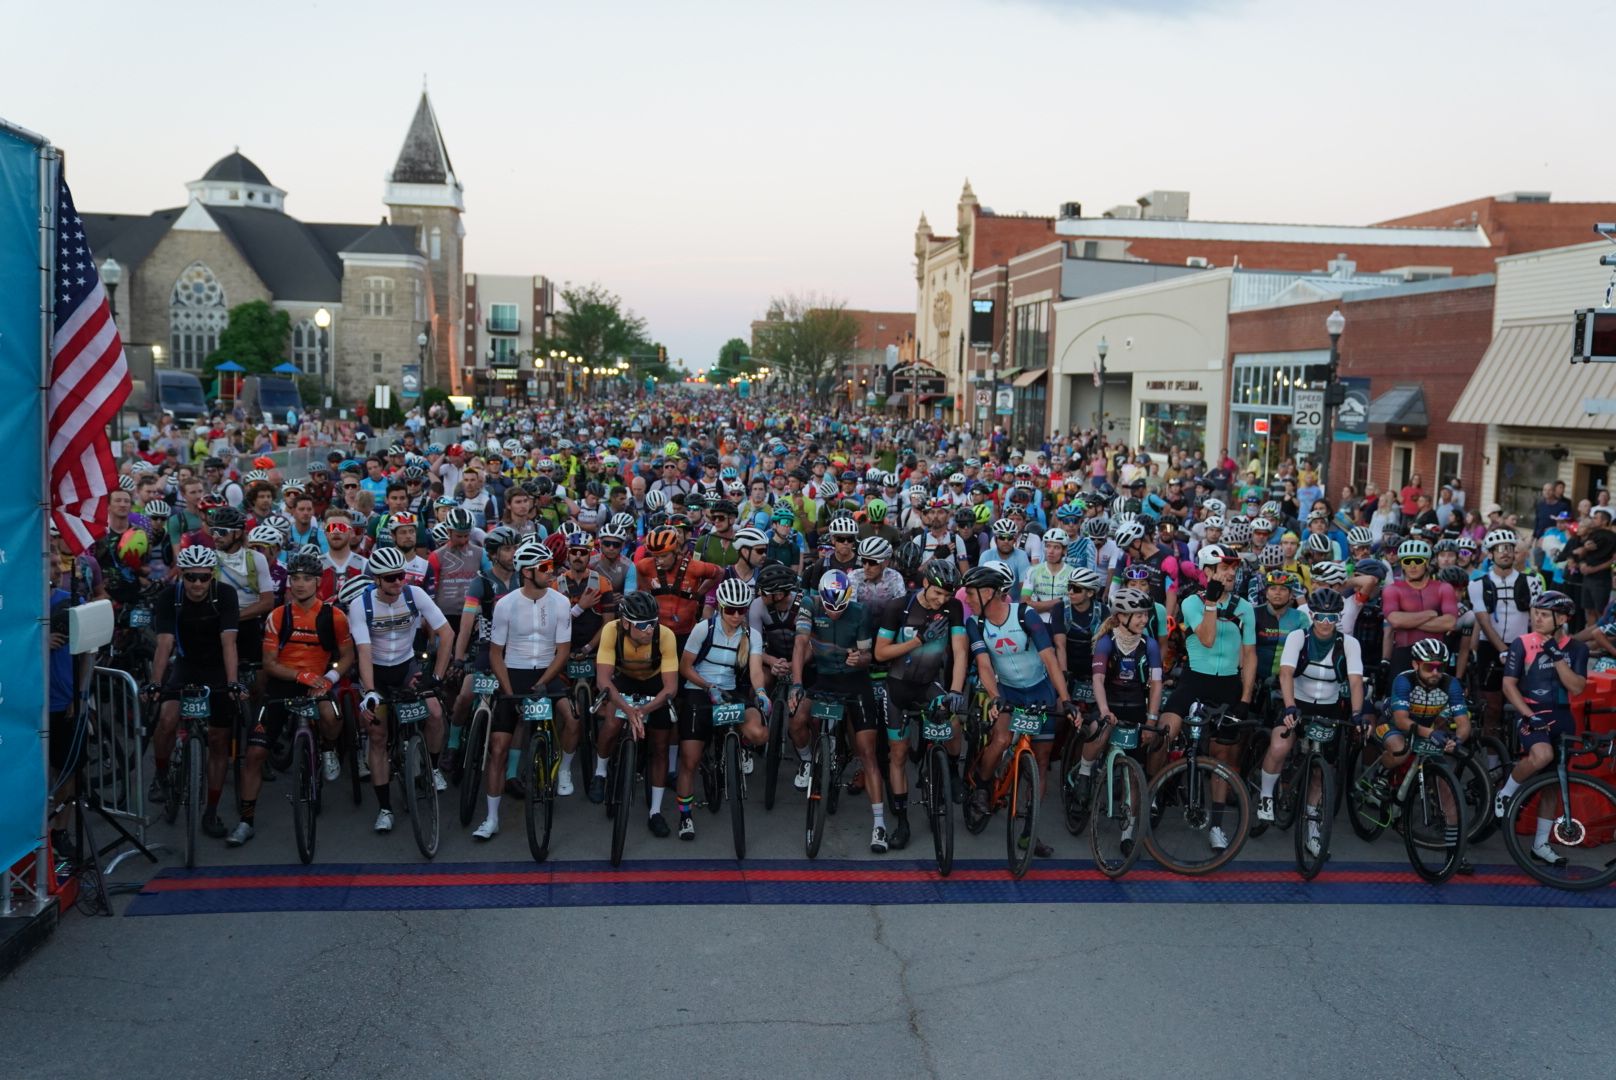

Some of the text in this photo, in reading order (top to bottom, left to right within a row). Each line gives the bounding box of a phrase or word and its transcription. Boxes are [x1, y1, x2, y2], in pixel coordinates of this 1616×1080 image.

[904, 369, 937, 377] GRNADA
[1296, 411, 1321, 425] 20
[570, 664, 592, 673] 3150
[475, 679, 500, 689] 2876
[1076, 688, 1094, 698] 219
[183, 702, 207, 712] 2814
[400, 706, 427, 718] 2292
[525, 703, 550, 714] 2007
[825, 706, 830, 714] 1
[717, 710, 741, 721] 2717
[1013, 718, 1040, 730] 2283
[924, 726, 952, 737] 2049
[1124, 735, 1129, 743] 1
